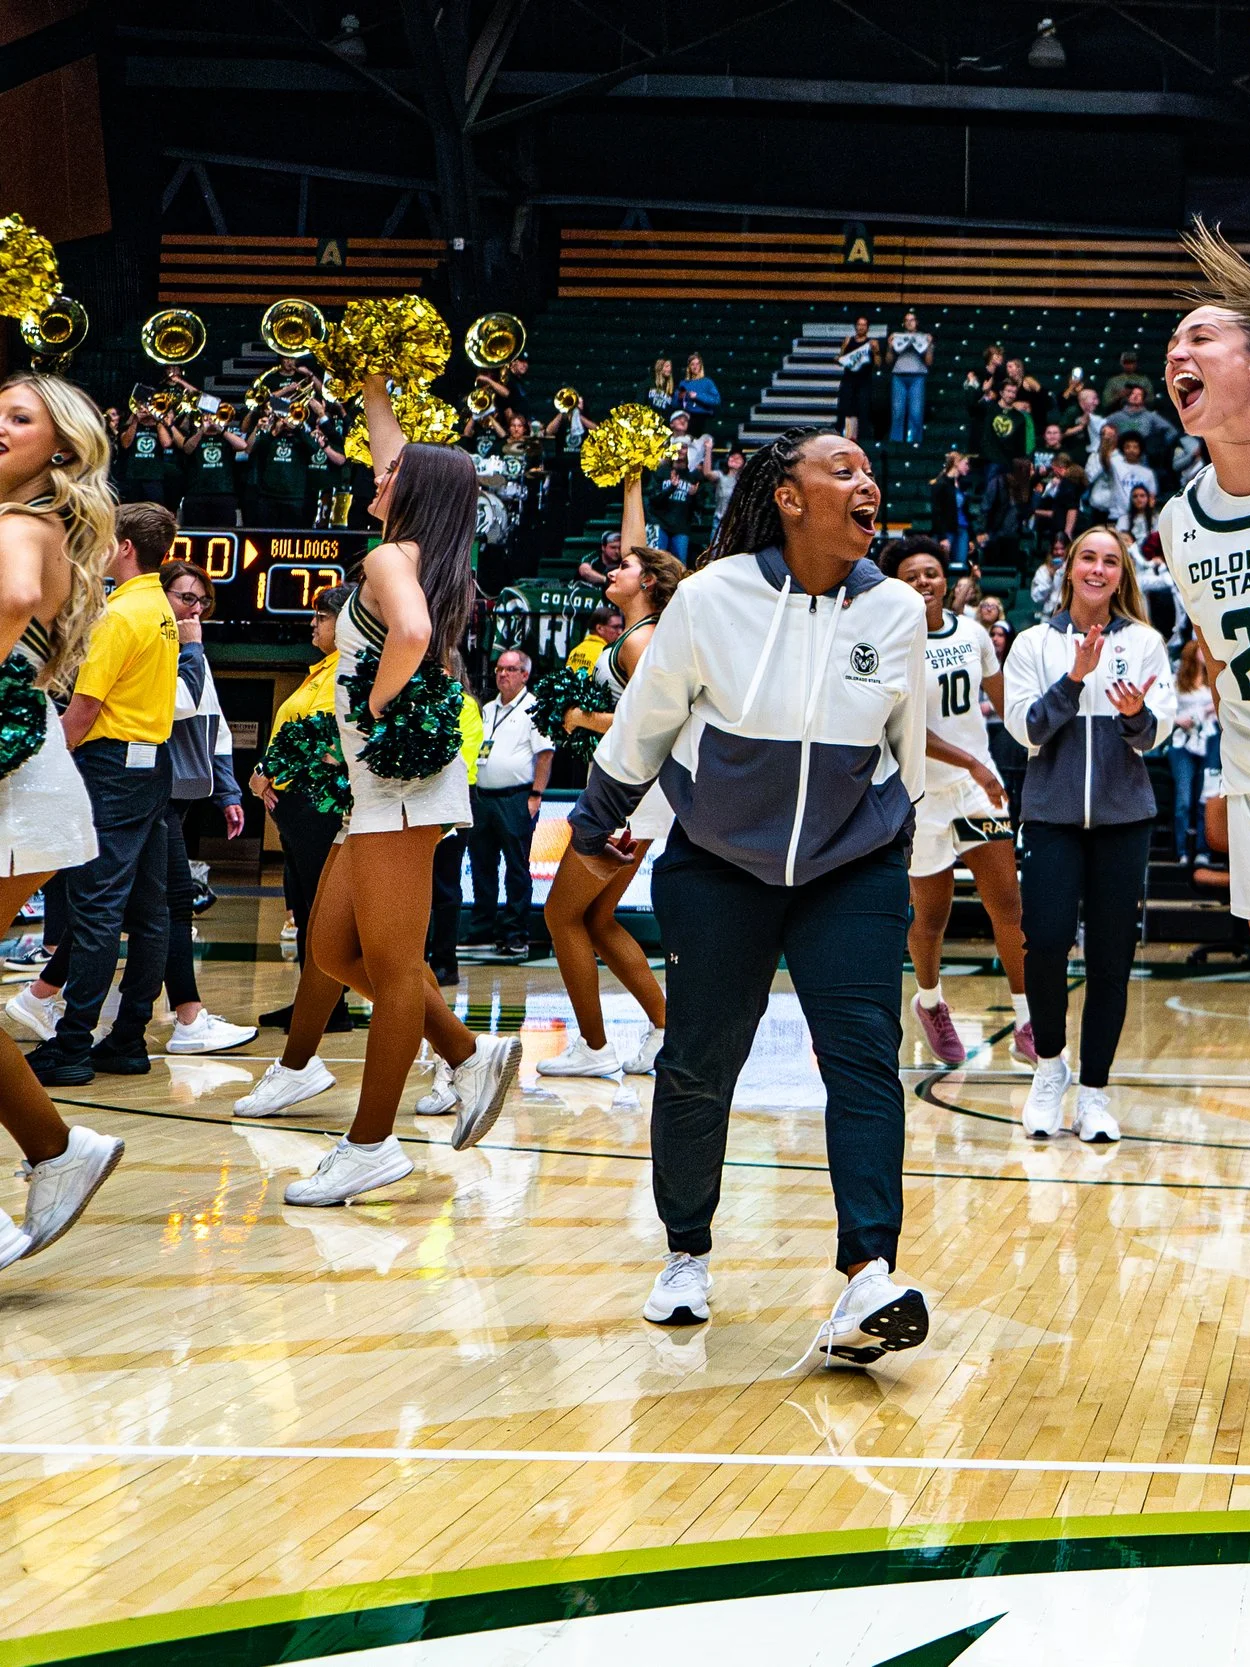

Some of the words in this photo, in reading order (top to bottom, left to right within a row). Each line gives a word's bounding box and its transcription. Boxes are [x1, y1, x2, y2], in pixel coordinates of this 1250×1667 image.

[320, 240, 342, 265] A
[848, 239, 870, 262] A
[271, 539, 339, 559] BULLDOGS
[541, 592, 616, 610] COLORA
[931, 655, 967, 669] STATE
[938, 669, 970, 718] 10
